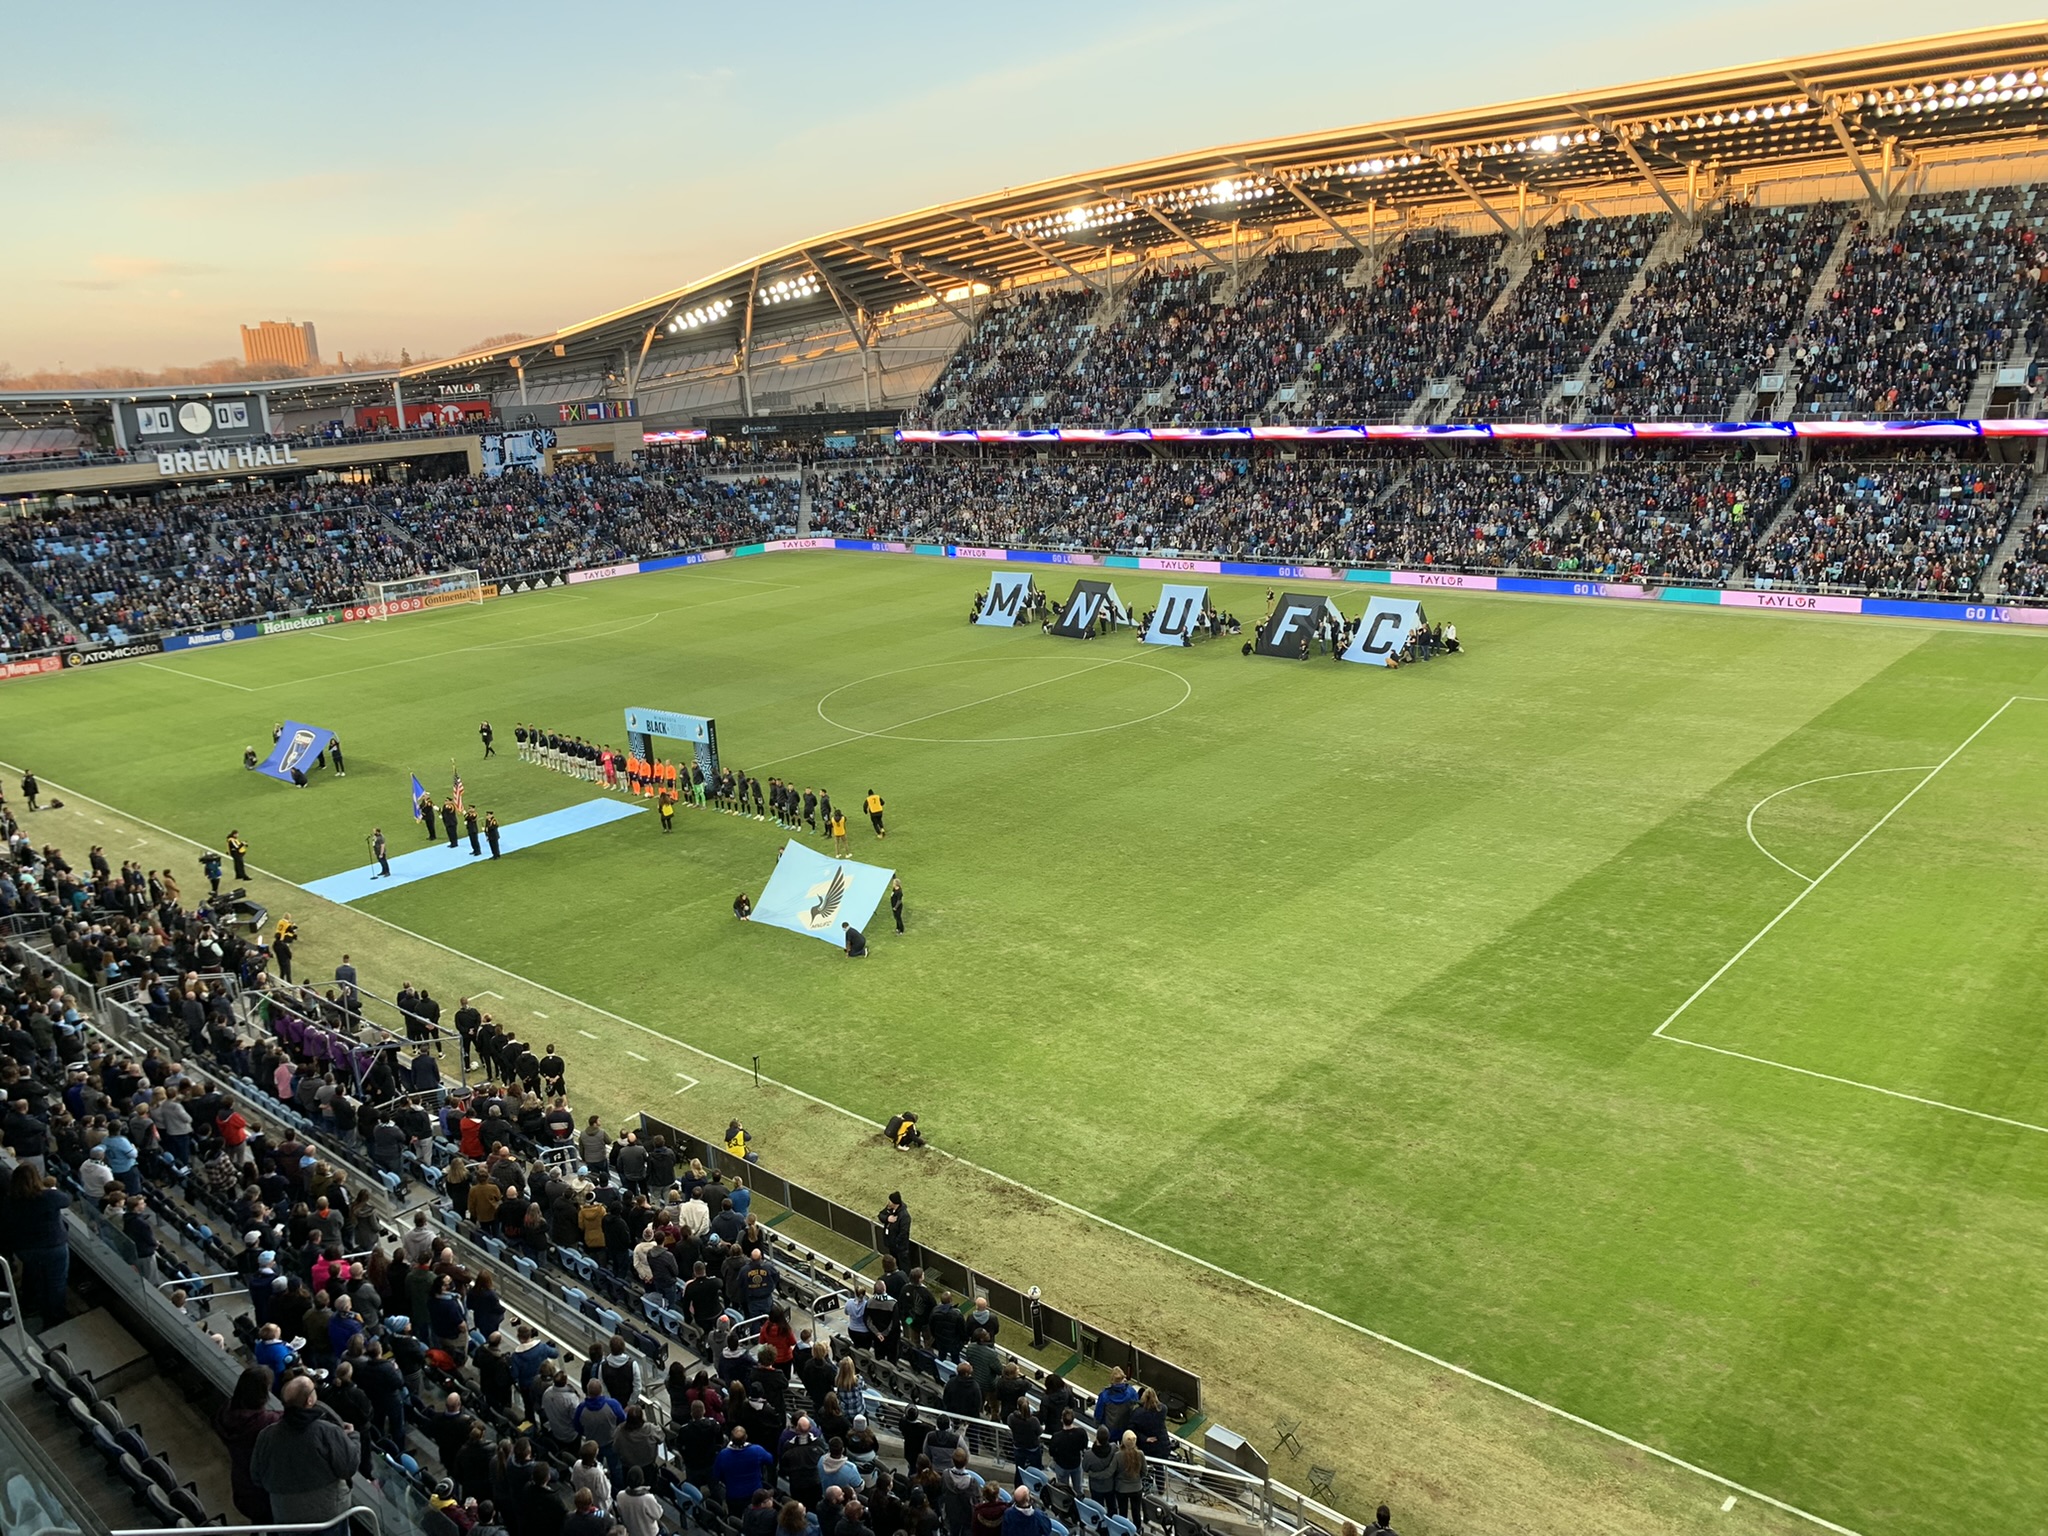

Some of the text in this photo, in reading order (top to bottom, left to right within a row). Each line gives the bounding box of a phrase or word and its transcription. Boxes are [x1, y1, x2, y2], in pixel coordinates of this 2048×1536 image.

[438, 383, 481, 394] TAYLOR
[159, 412, 169, 428] 0
[218, 408, 229, 424] 0
[157, 444, 298, 475] BREW HALL
[782, 540, 817, 548] TAYLOR
[959, 549, 987, 557] TAYLOR
[1052, 554, 1061, 563] GO
[686, 556, 696, 564] GO
[1161, 560, 1195, 570] TAYLOR
[583, 568, 617, 580] TAYLOR
[1279, 567, 1291, 577] GO
[1419, 575, 1463, 586] TAYLOR
[1573, 584, 1589, 594] GO
[425, 591, 469, 606] Continental
[1758, 595, 1816, 608] TAYLOR
[1966, 607, 1986, 620] GO
[262, 614, 325, 635] Heineken
[188, 633, 222, 645] Allianz
[84, 644, 159, 663] ATOMICdata
[6, 662, 40, 677] Morgan
[646, 720, 668, 735] BLACK
[553, 1152, 562, 1161] F2
[827, 1299, 836, 1308] F1
